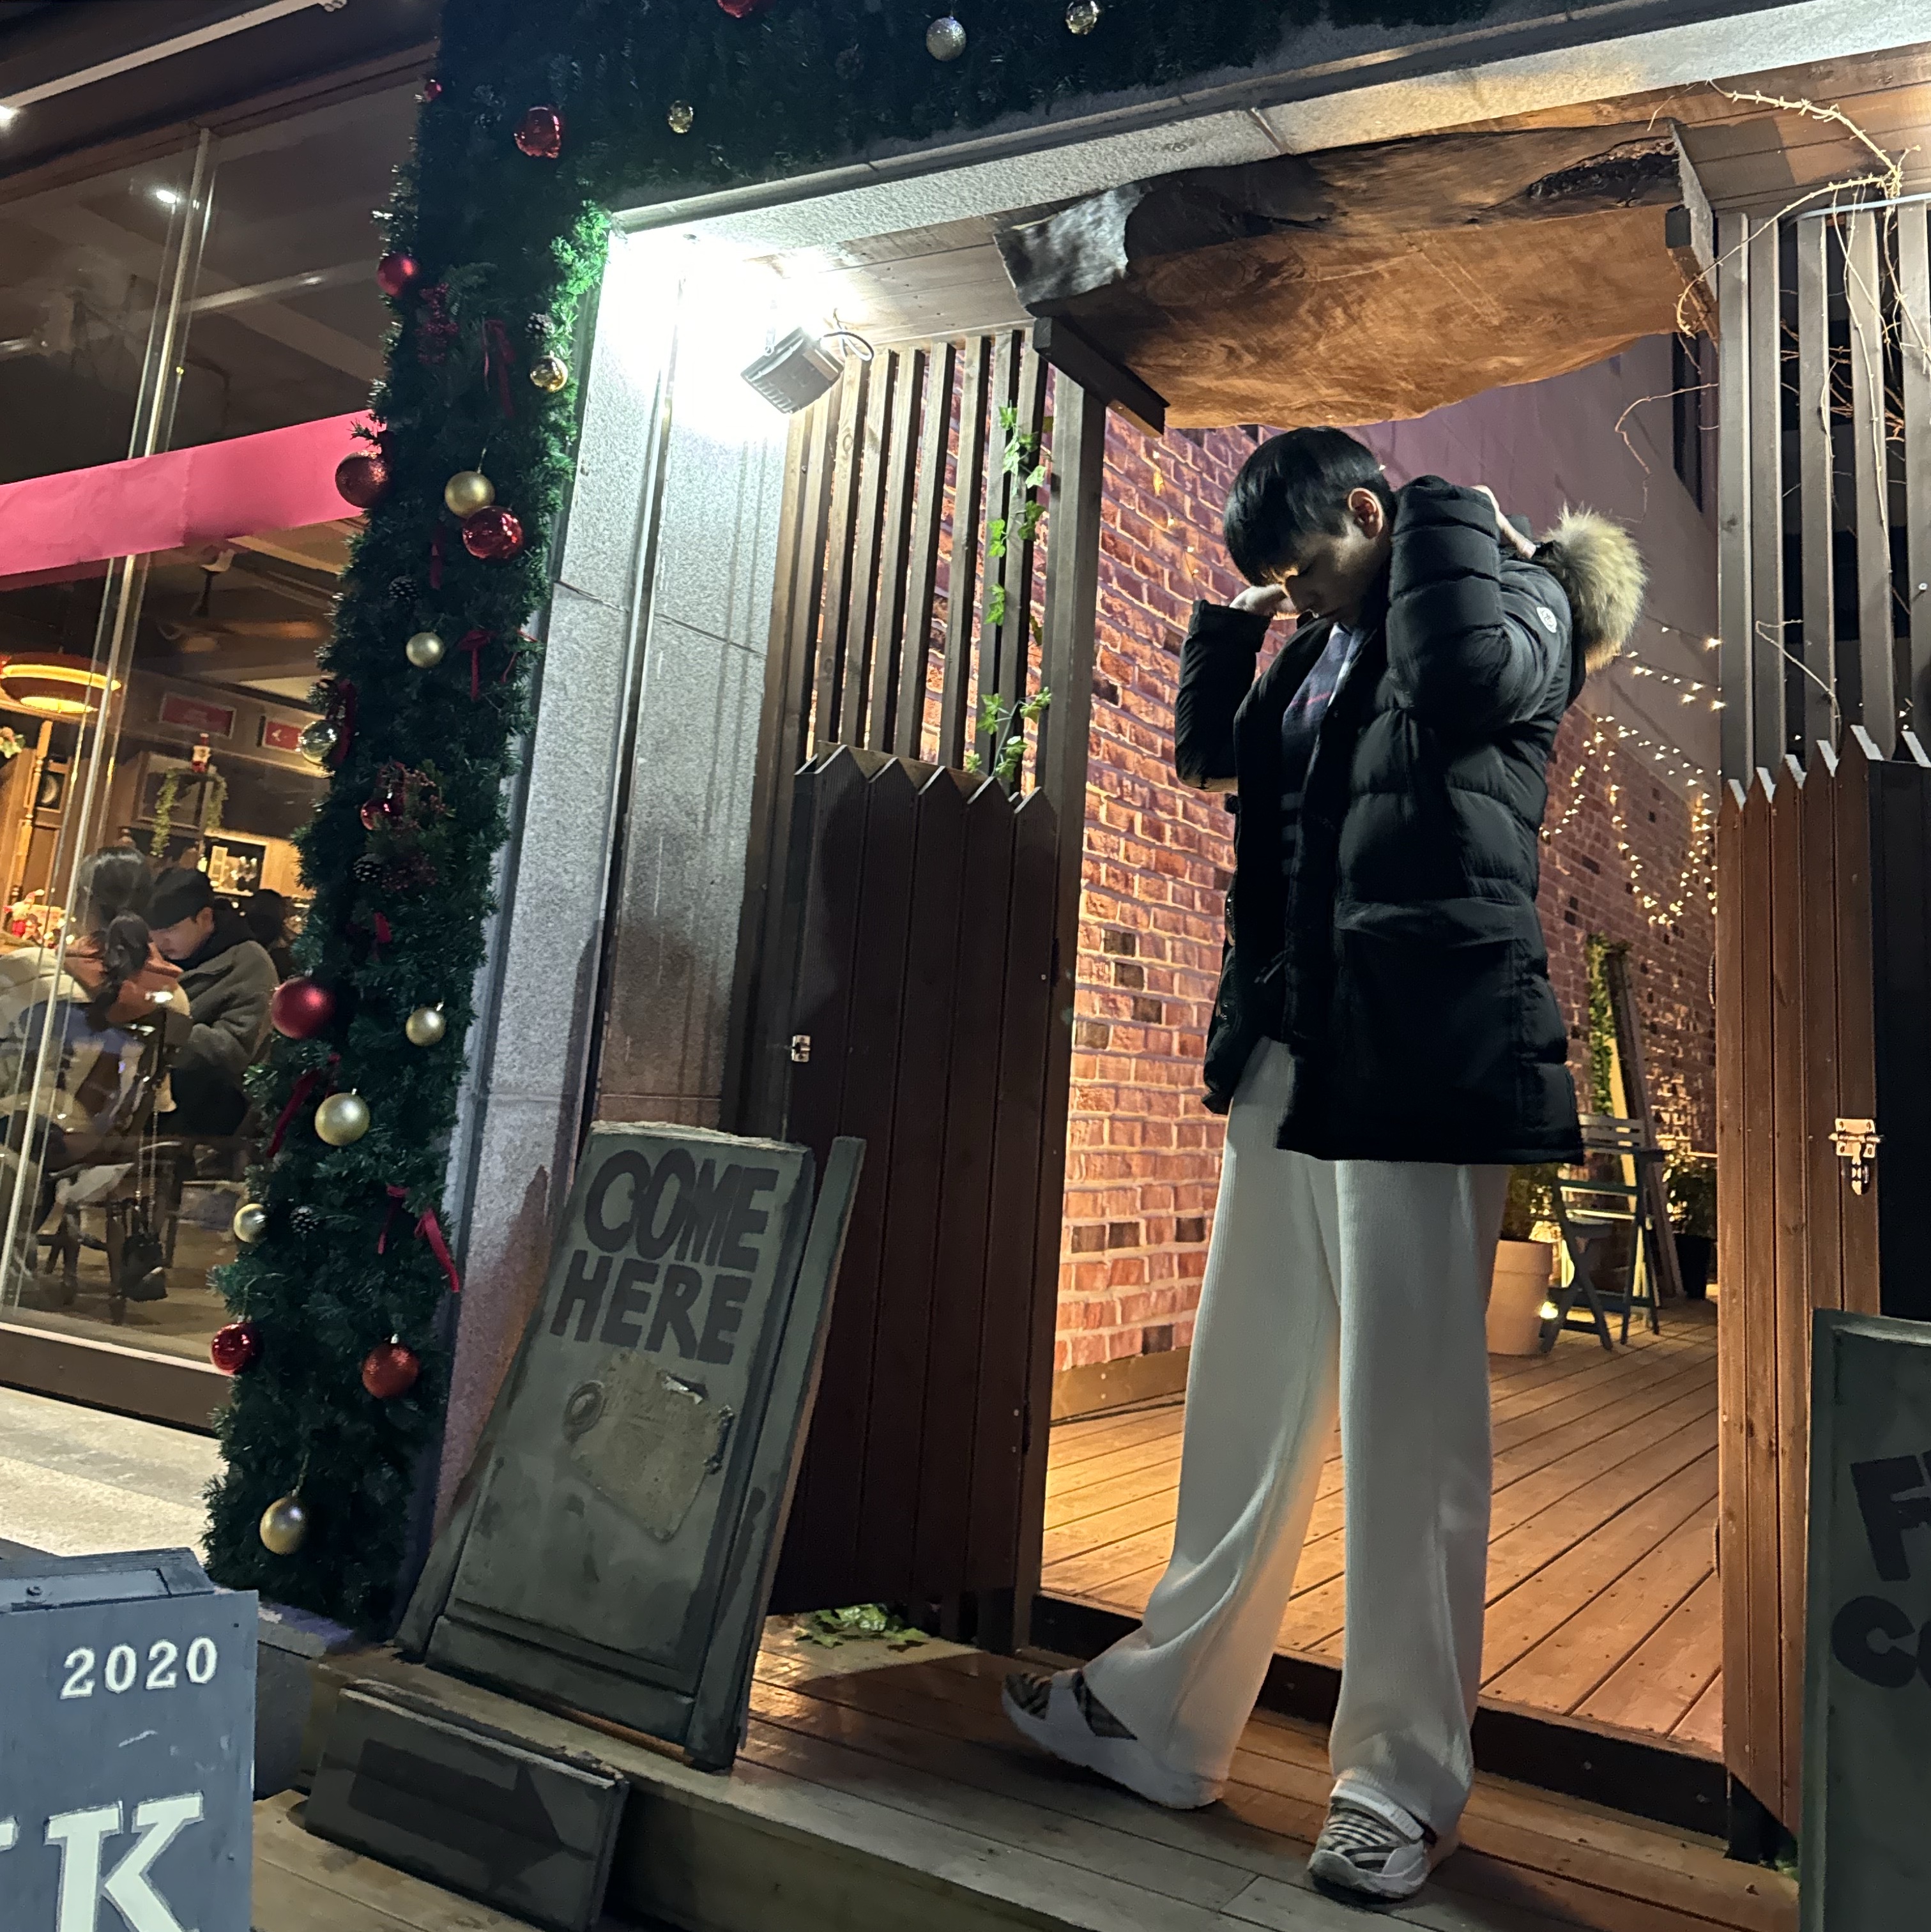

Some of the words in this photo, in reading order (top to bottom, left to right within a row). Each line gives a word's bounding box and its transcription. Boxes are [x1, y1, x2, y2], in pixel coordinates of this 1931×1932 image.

[586, 1150, 779, 1272] COME
[551, 1250, 752, 1364] HERE
[1851, 1451, 1931, 1580] F
[61, 1637, 217, 1698] 2020
[1830, 1595, 1931, 1689] C
[0, 1791, 204, 1932] K
